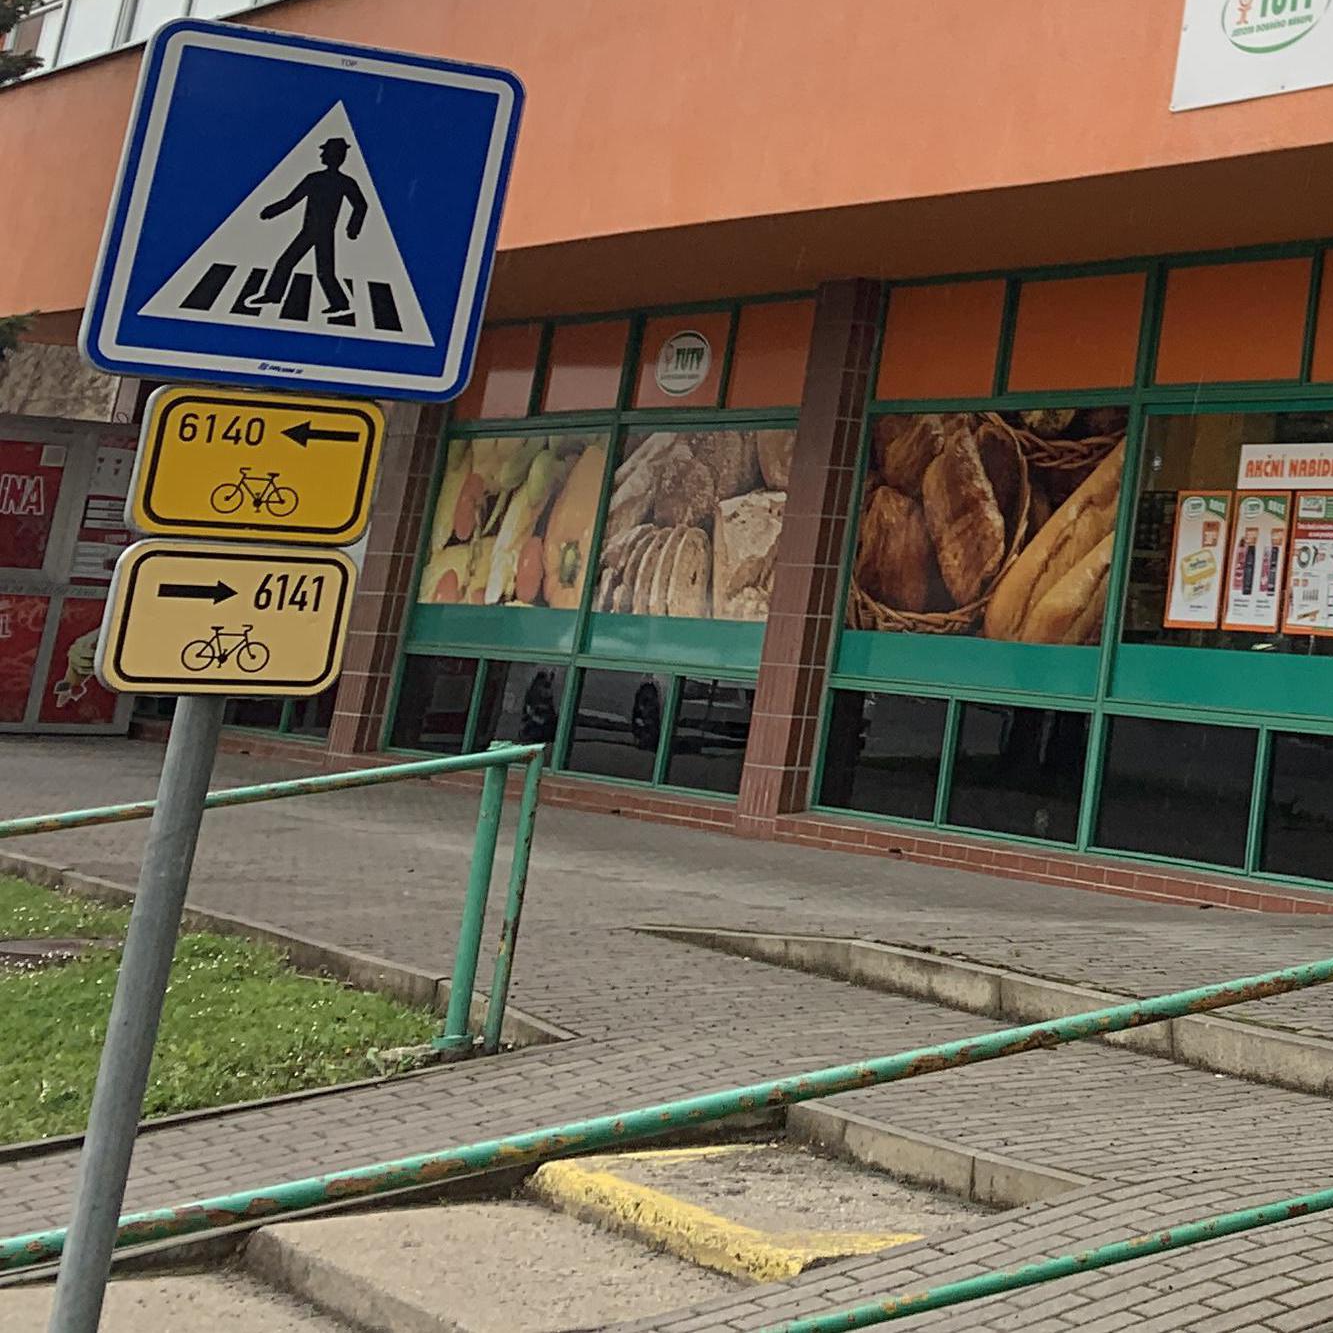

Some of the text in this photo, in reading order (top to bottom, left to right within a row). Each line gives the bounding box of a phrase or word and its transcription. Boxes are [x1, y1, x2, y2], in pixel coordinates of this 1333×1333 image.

[675, 348, 705, 370] TUTY
[179, 413, 265, 446] 6140
[1244, 454, 1286, 478] AKČNÍ
[254, 573, 325, 612] 6141
